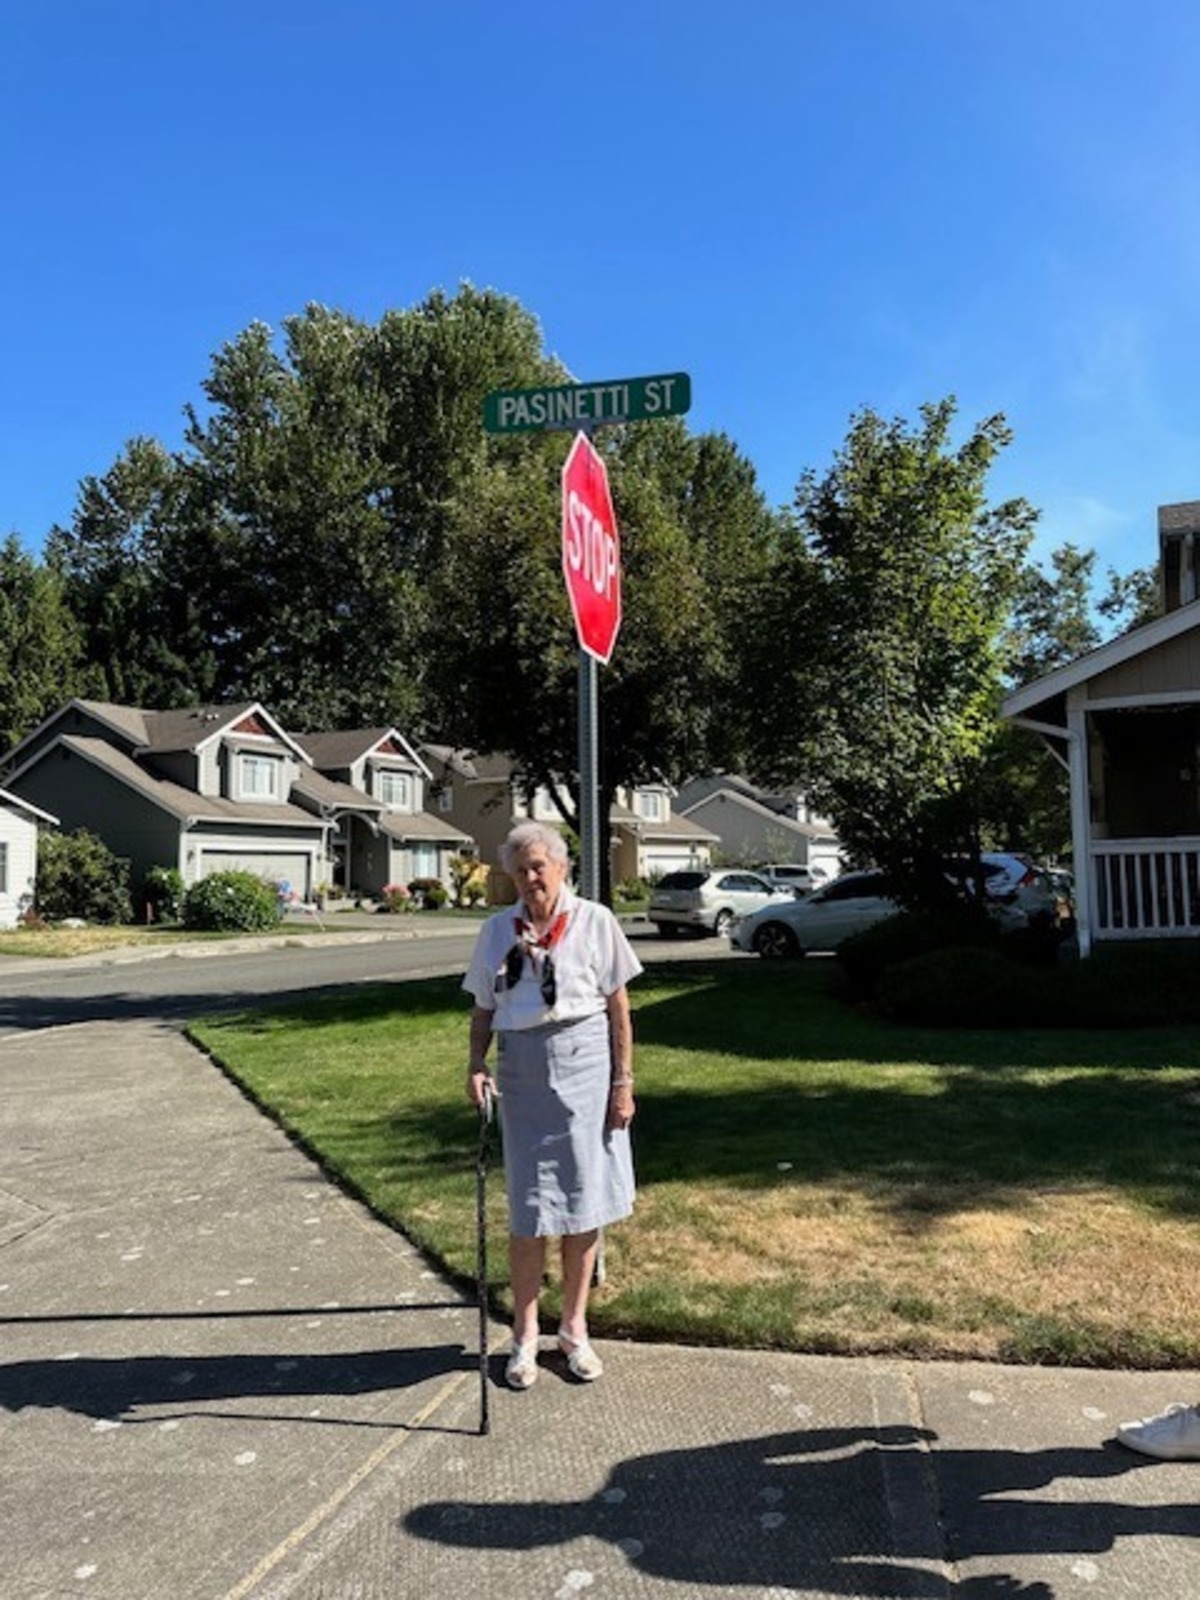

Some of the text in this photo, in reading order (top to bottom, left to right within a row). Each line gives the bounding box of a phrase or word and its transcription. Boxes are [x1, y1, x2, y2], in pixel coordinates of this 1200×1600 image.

[499, 379, 676, 427] PASINETTI ST
[568, 490, 615, 600] STOP
